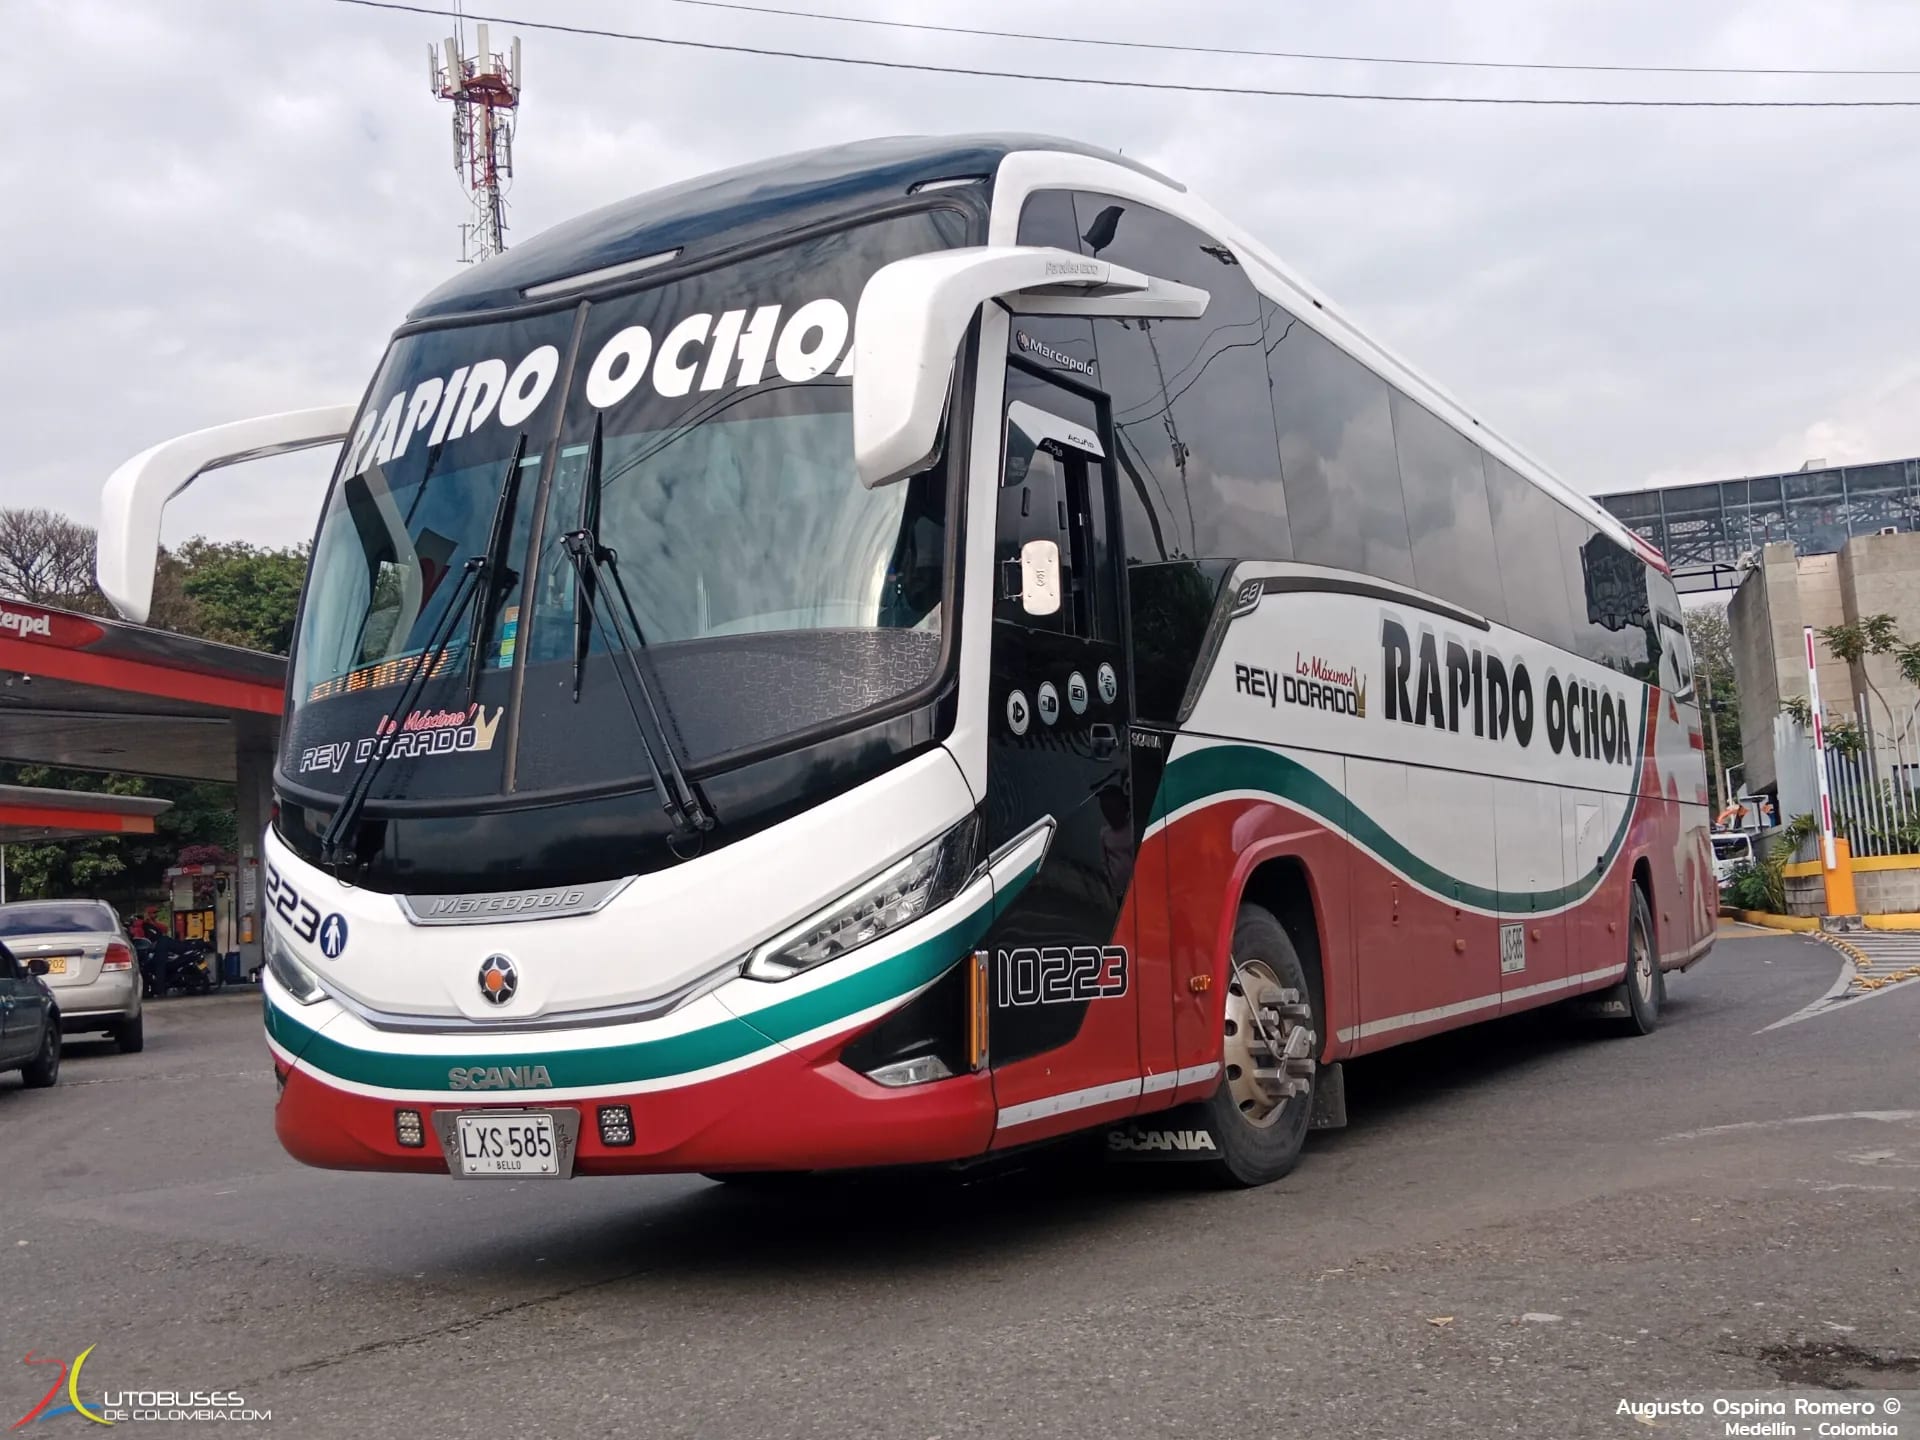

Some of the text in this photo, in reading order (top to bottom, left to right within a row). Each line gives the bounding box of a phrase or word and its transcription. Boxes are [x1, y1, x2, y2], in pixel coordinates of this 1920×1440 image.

[1030, 338, 1094, 376] Marcopolo
[344, 298, 855, 481] RAPIDO OCHO
[1239, 582, 1259, 604] G8
[1296, 651, 1354, 687] Lo Máximo!
[1235, 663, 1358, 716] REY DORADO
[1381, 615, 1632, 766] RAPIDO OCHOA
[300, 741, 350, 773] REY
[429, 889, 584, 915] Marcopolo
[998, 945, 1129, 1007] 10223
[448, 1065, 553, 1089] SCANIA
[462, 1126, 551, 1158] LXS 585
[1107, 1130, 1217, 1151] SCANIA
[497, 1161, 521, 1170] BELLO
